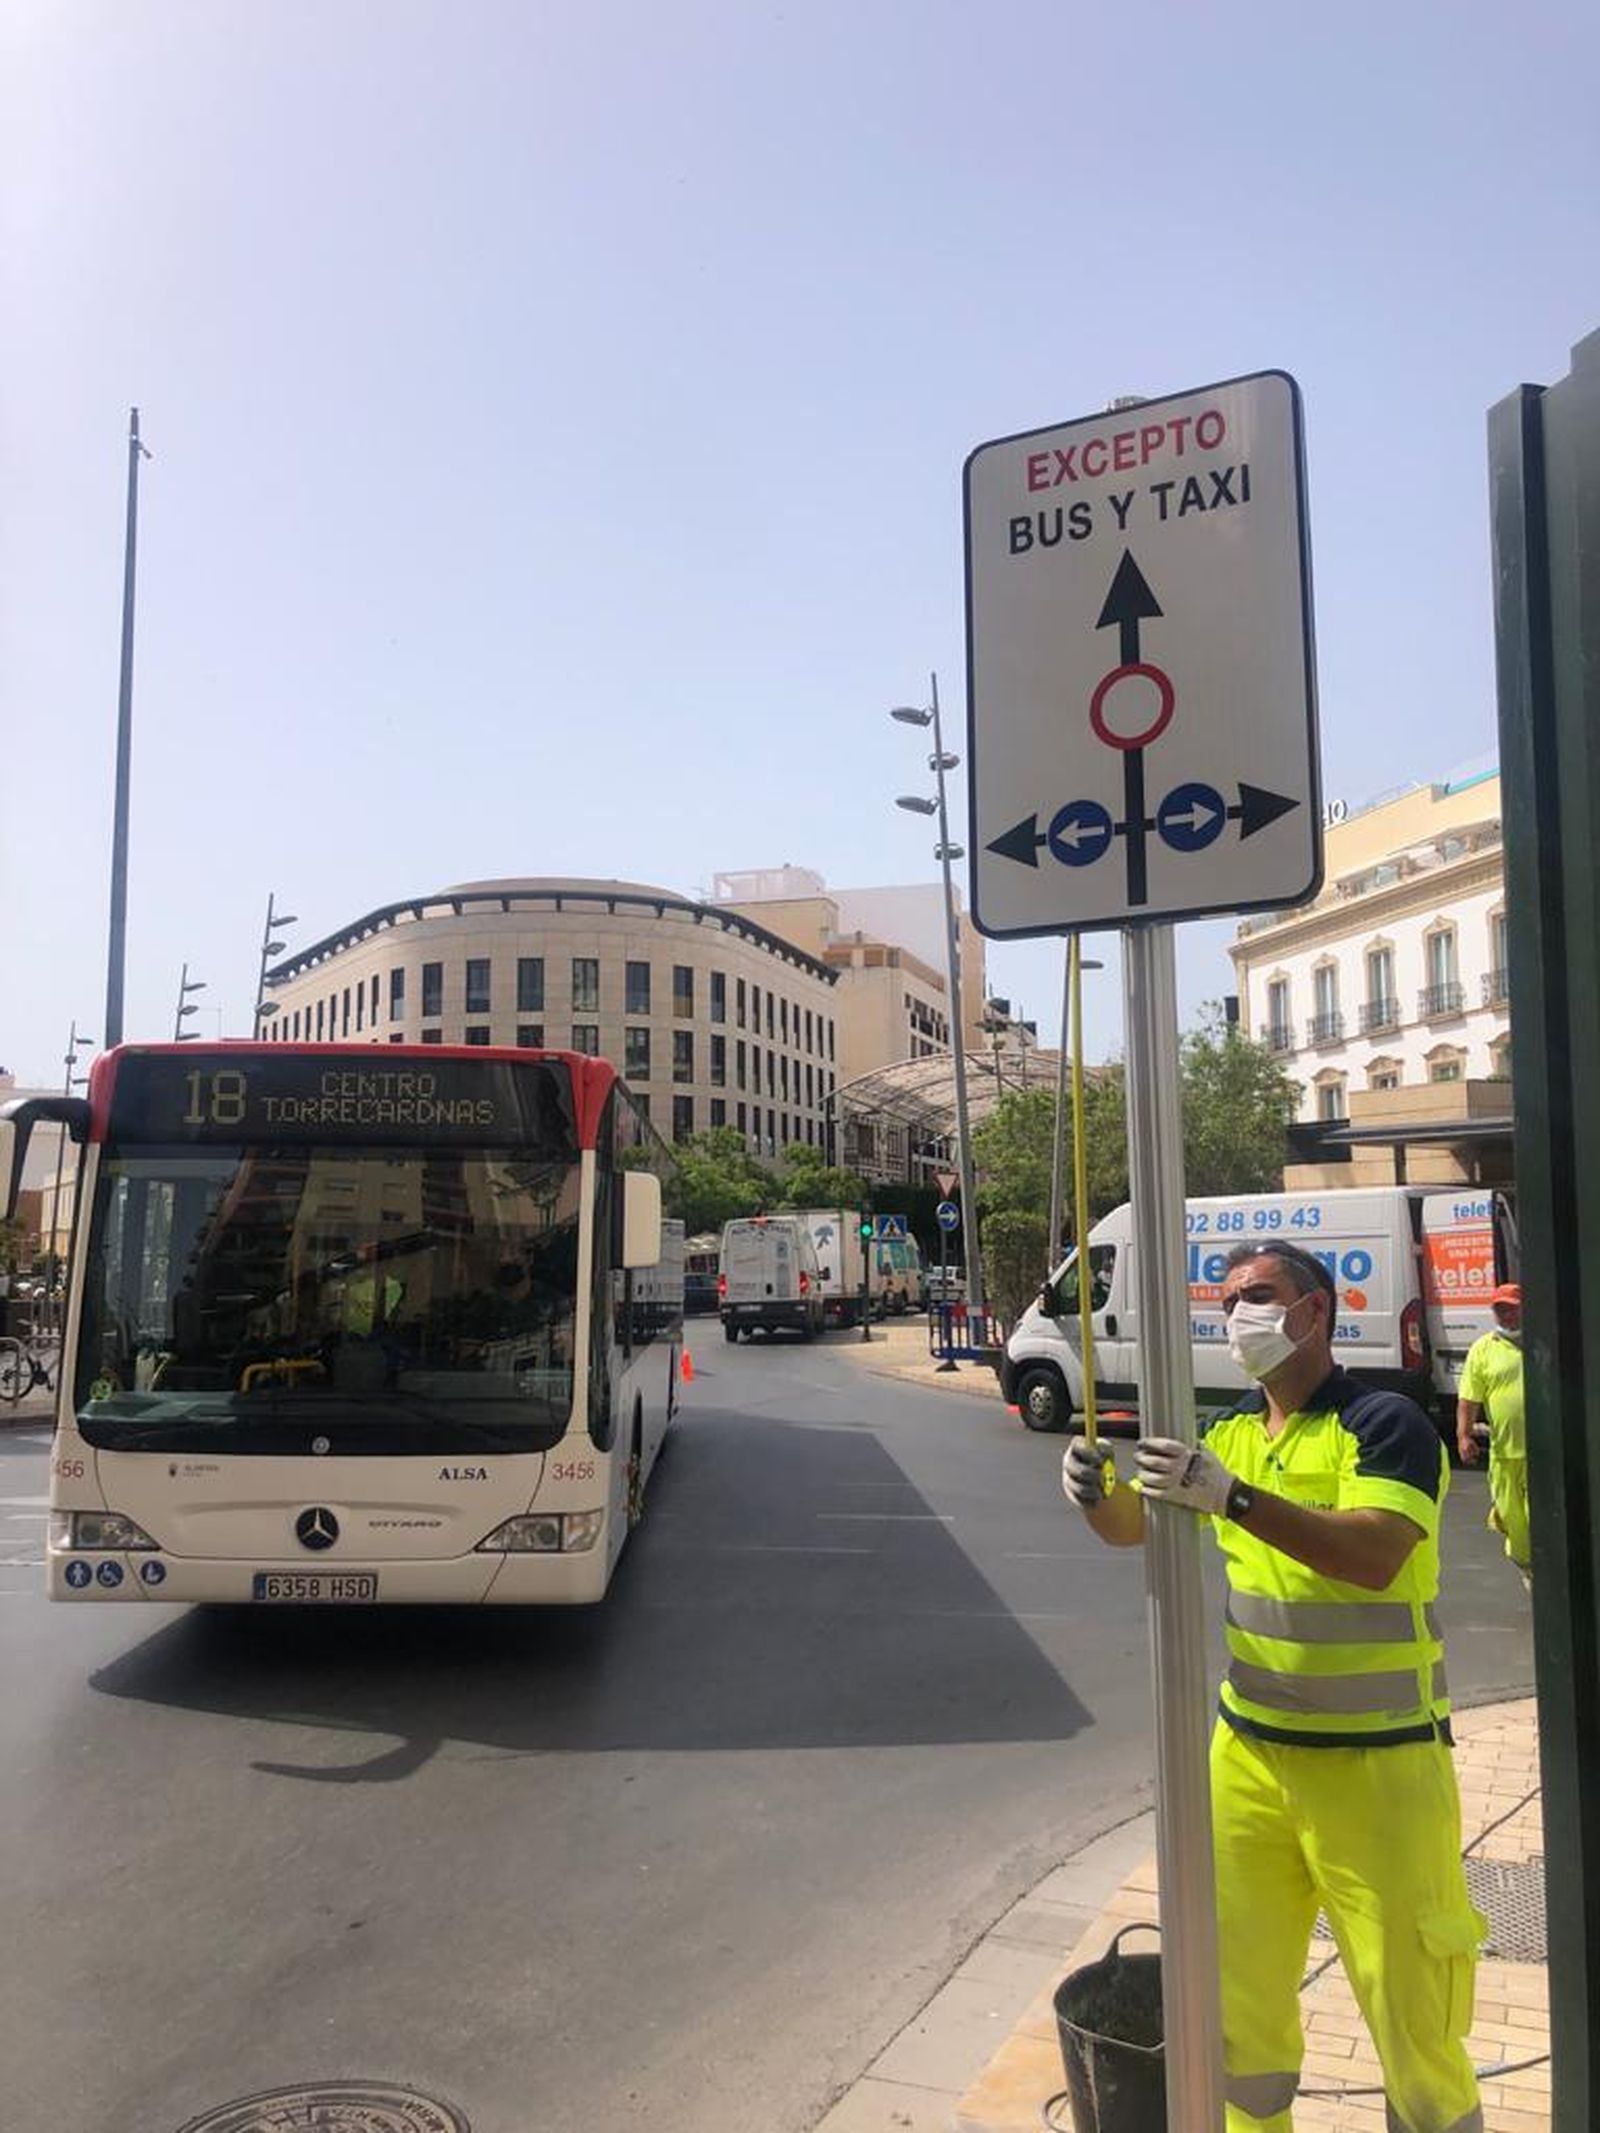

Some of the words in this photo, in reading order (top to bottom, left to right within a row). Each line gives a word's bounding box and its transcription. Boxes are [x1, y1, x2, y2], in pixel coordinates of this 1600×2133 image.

[1027, 410, 1226, 492] EXCEPTO
[1009, 501, 1093, 554] BUS
[1108, 490, 1135, 530] Y
[1150, 464, 1251, 521] TAXI
[183, 1069, 247, 1124] 18
[321, 1072, 435, 1097] CENTRO
[1183, 1213, 1208, 1233] 02
[1217, 1211, 1245, 1233] 88
[1253, 1209, 1282, 1230] 99
[1291, 1207, 1321, 1228] 43
[438, 1467, 489, 1481] ALSA
[552, 1461, 595, 1480] 3456
[268, 1578, 320, 1598] 6358
[331, 1578, 370, 1599] HSD
